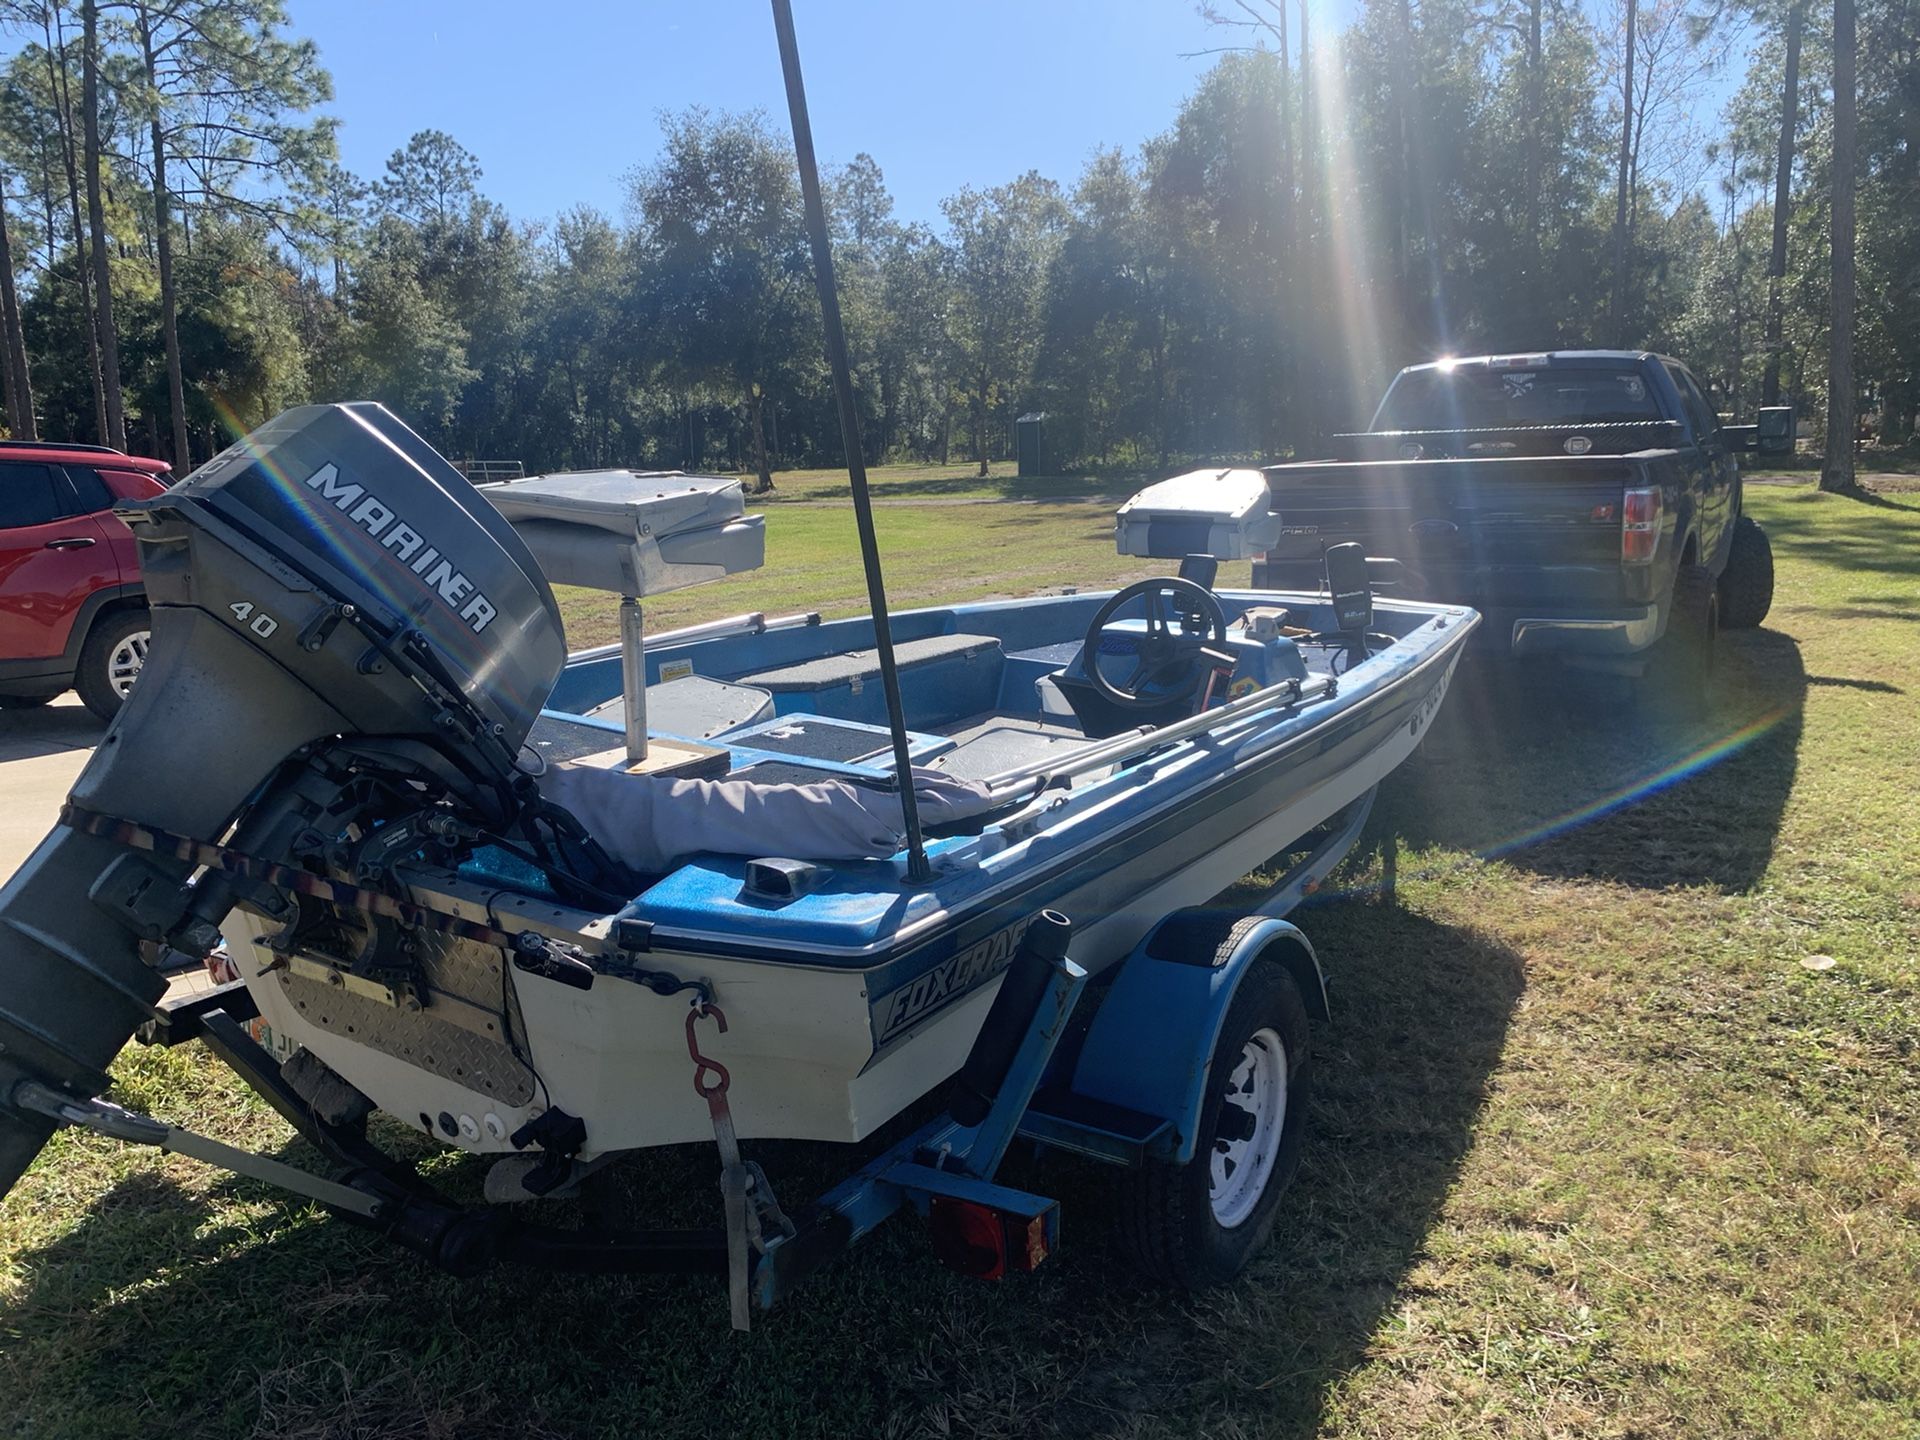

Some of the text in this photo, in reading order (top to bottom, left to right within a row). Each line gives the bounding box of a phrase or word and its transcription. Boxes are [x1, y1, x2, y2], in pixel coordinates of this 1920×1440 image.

[306, 463, 497, 634] MARINER
[229, 601, 279, 639] 40
[884, 916, 1038, 1031] FOXCRAF
